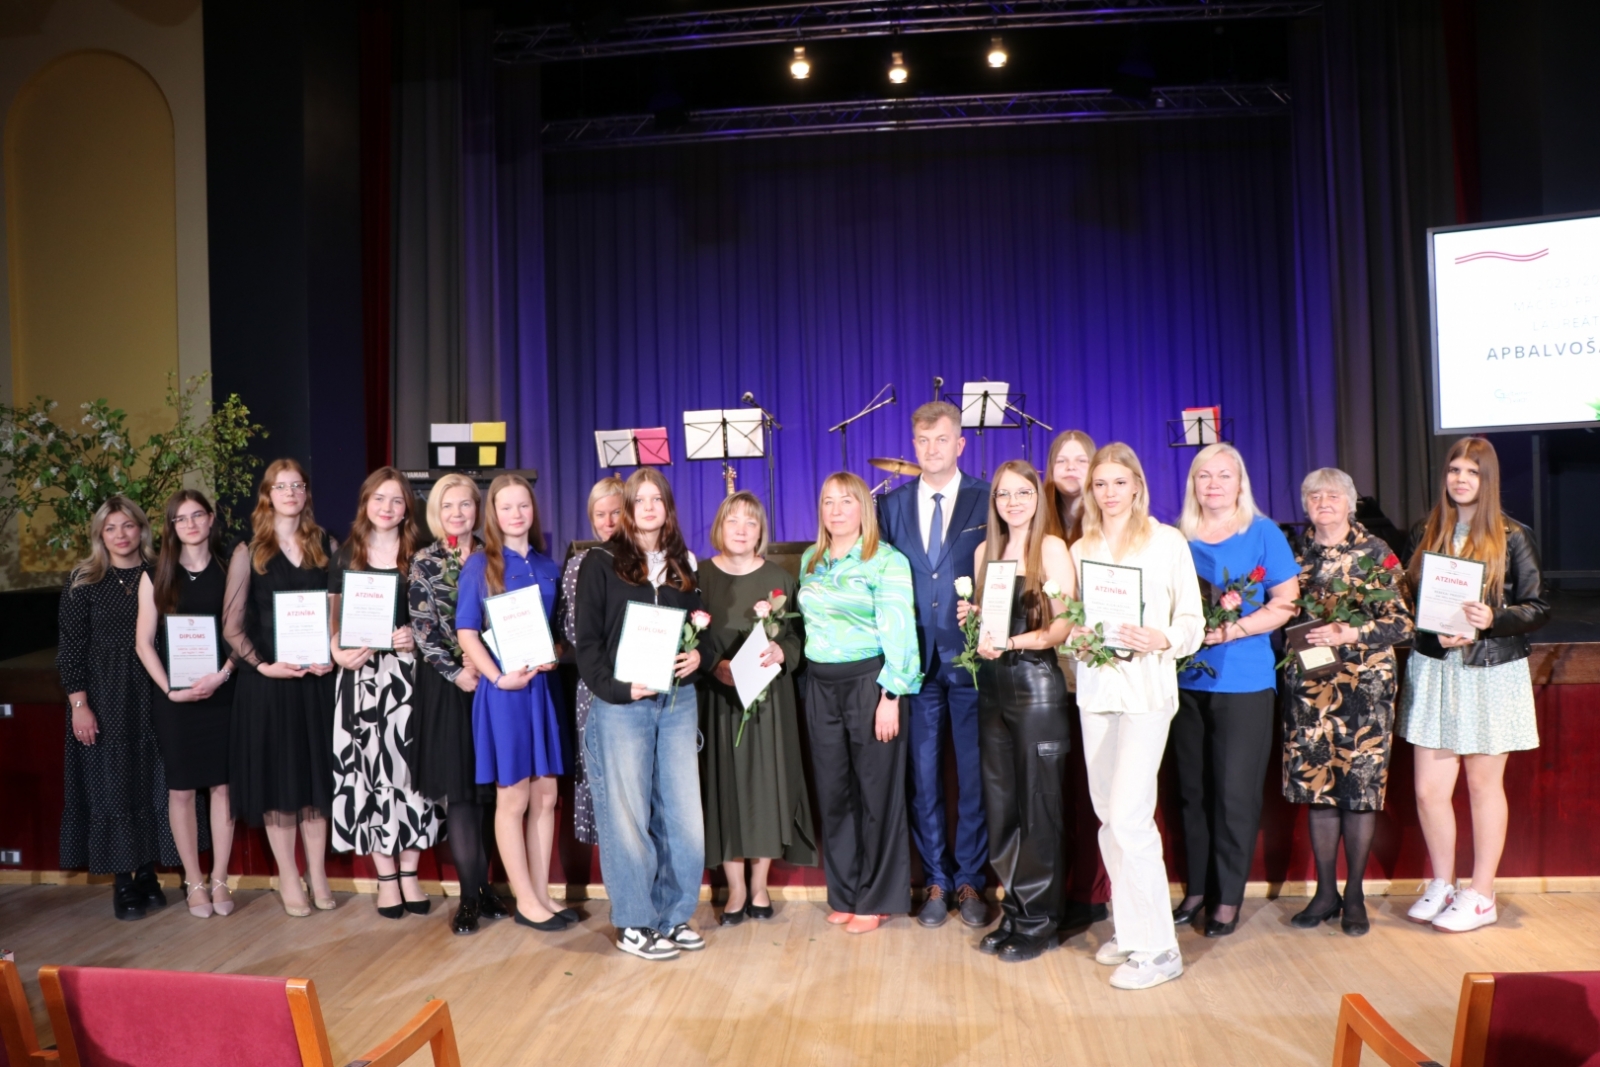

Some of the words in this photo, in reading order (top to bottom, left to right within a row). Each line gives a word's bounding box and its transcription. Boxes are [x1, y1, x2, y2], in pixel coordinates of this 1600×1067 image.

[1486, 336, 1600, 361] APBALVOŠ
[407, 471, 429, 479] YAMAHA
[1435, 575, 1468, 586] ATZINĪBA
[355, 591, 384, 599] ATZINĪBA
[1095, 585, 1127, 595] ATZINĪBA
[503, 610, 531, 621] DIPLOMS
[637, 625, 667, 634] DIPLOMS
